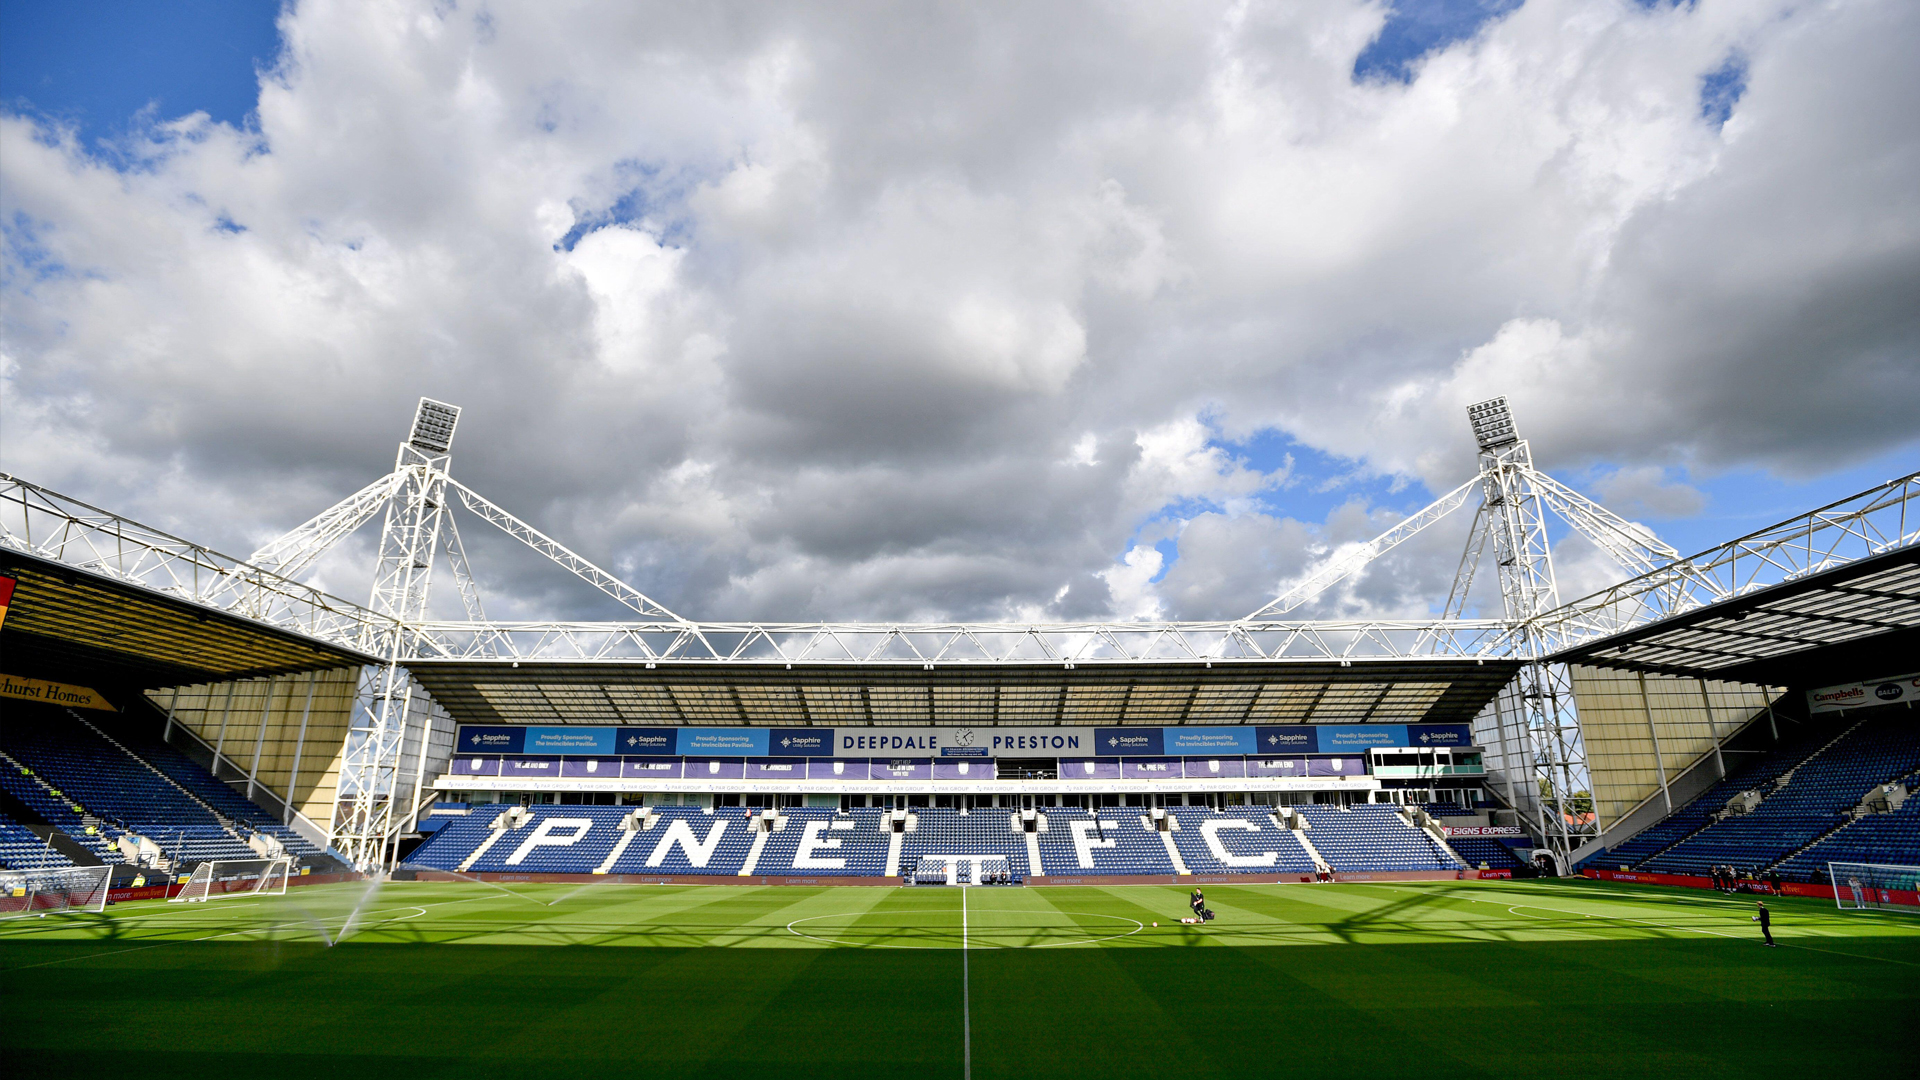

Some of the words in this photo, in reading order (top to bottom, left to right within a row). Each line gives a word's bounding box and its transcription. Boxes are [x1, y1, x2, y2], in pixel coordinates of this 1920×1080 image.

[45, 685, 92, 705] Homes
[1814, 688, 1864, 701] Campbells
[1878, 688, 1900, 696] BAILEY
[844, 736, 937, 749] DEEPDALE
[993, 736, 1079, 749] PRESTON
[506, 818, 592, 865] P
[645, 820, 729, 868] N
[792, 820, 855, 869] E
[1070, 820, 1120, 868] F
[1200, 819, 1279, 866] C
